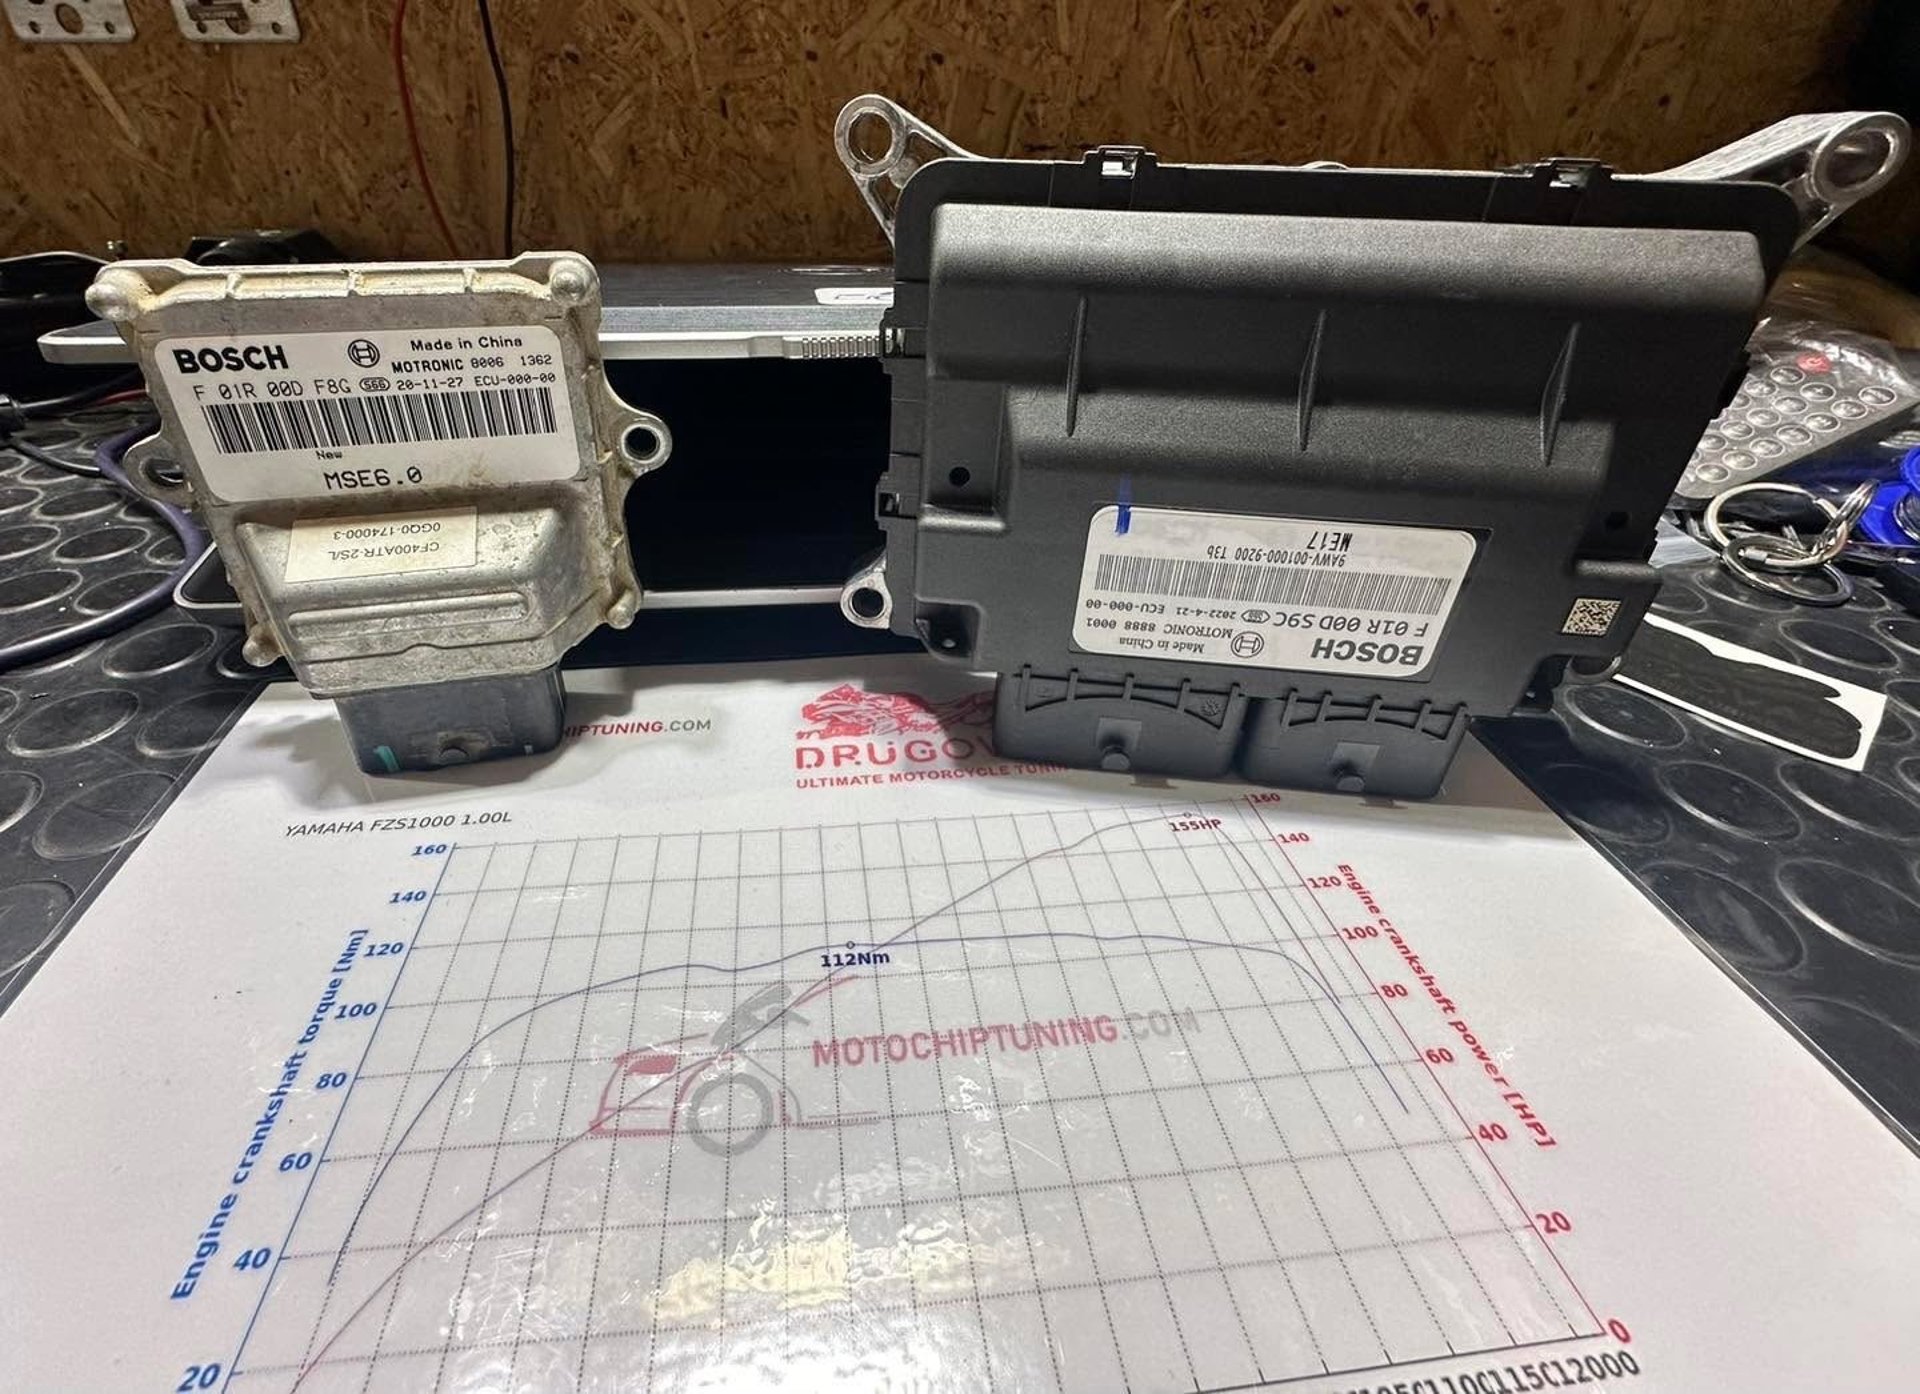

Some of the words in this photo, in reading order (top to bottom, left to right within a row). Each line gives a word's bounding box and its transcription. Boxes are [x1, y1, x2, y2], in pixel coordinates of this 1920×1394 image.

[410, 338, 453, 352] Made
[459, 337, 473, 349] in
[478, 336, 522, 349] China
[172, 345, 289, 374] BOSCH
[391, 358, 464, 374] MOTRONIC
[470, 356, 504, 368] 8006
[520, 354, 552, 366] 1362
[193, 385, 205, 399] F
[218, 383, 258, 399] 01R
[267, 380, 304, 397] 00D
[314, 378, 352, 394] F8G
[396, 377, 464, 391] 20-11-27
[474, 372, 556, 387] ECU-000-00
[316, 451, 343, 460] New
[323, 466, 423, 490] MSE6.0
[1307, 531, 1353, 552] ME17
[328, 541, 440, 561] CF400ATR-2S/L
[1234, 547, 1346, 567] 9AWV-001000-9200
[1086, 599, 1165, 614] ECU-000-00
[1176, 607, 1236, 619] 2022-4-21
[1086, 618, 1117, 629] 0001
[1124, 621, 1156, 632] 8888
[1273, 611, 1316, 629] S9C
[1319, 614, 1361, 632] 00D
[1368, 619, 1408, 636] 01R
[1163, 624, 1233, 639] MOTRONIC
[1413, 622, 1429, 637] F
[1119, 637, 1154, 649] China
[1157, 638, 1169, 649] in
[1172, 641, 1204, 653] Made
[1310, 638, 1425, 666] BOSCH
[796, 775, 884, 789] ULTIMATE
[889, 765, 1010, 783] MOTORCYCLE
[1250, 793, 1280, 803] 160
[286, 821, 364, 837] YAMAHA
[369, 815, 456, 831] FZS1000
[460, 812, 513, 825] 1.00L
[1169, 817, 1222, 833] 155HP
[1277, 832, 1310, 843] 140
[411, 844, 447, 856] 160
[1307, 874, 1342, 889] 120
[389, 890, 427, 904] 140
[1341, 925, 1379, 940] 100
[363, 942, 404, 958] 120
[820, 952, 890, 967] 112Nm
[1380, 984, 1409, 998] 80
[334, 1002, 378, 1020] 100
[1338, 863, 1381, 915] Engine
[1378, 917, 1456, 1014] crankshaft
[1448, 1019, 1511, 1088] power
[1503, 1092, 1557, 1148] [HP]
[811, 1006, 1200, 1068] MOTOCHIPTUNING.COM
[1425, 1047, 1455, 1065] 60
[316, 1072, 348, 1090] 80
[170, 1192, 238, 1299] Engine
[233, 1049, 308, 1184] crankshaft
[297, 977, 343, 1044] torque
[332, 929, 370, 973] [Nm]
[1478, 1123, 1508, 1142] 40
[279, 1152, 313, 1172] 60
[1536, 1210, 1572, 1234] 20
[233, 1247, 272, 1271] 40
[1607, 1318, 1632, 1344] 0
[177, 1363, 221, 1393] 20
